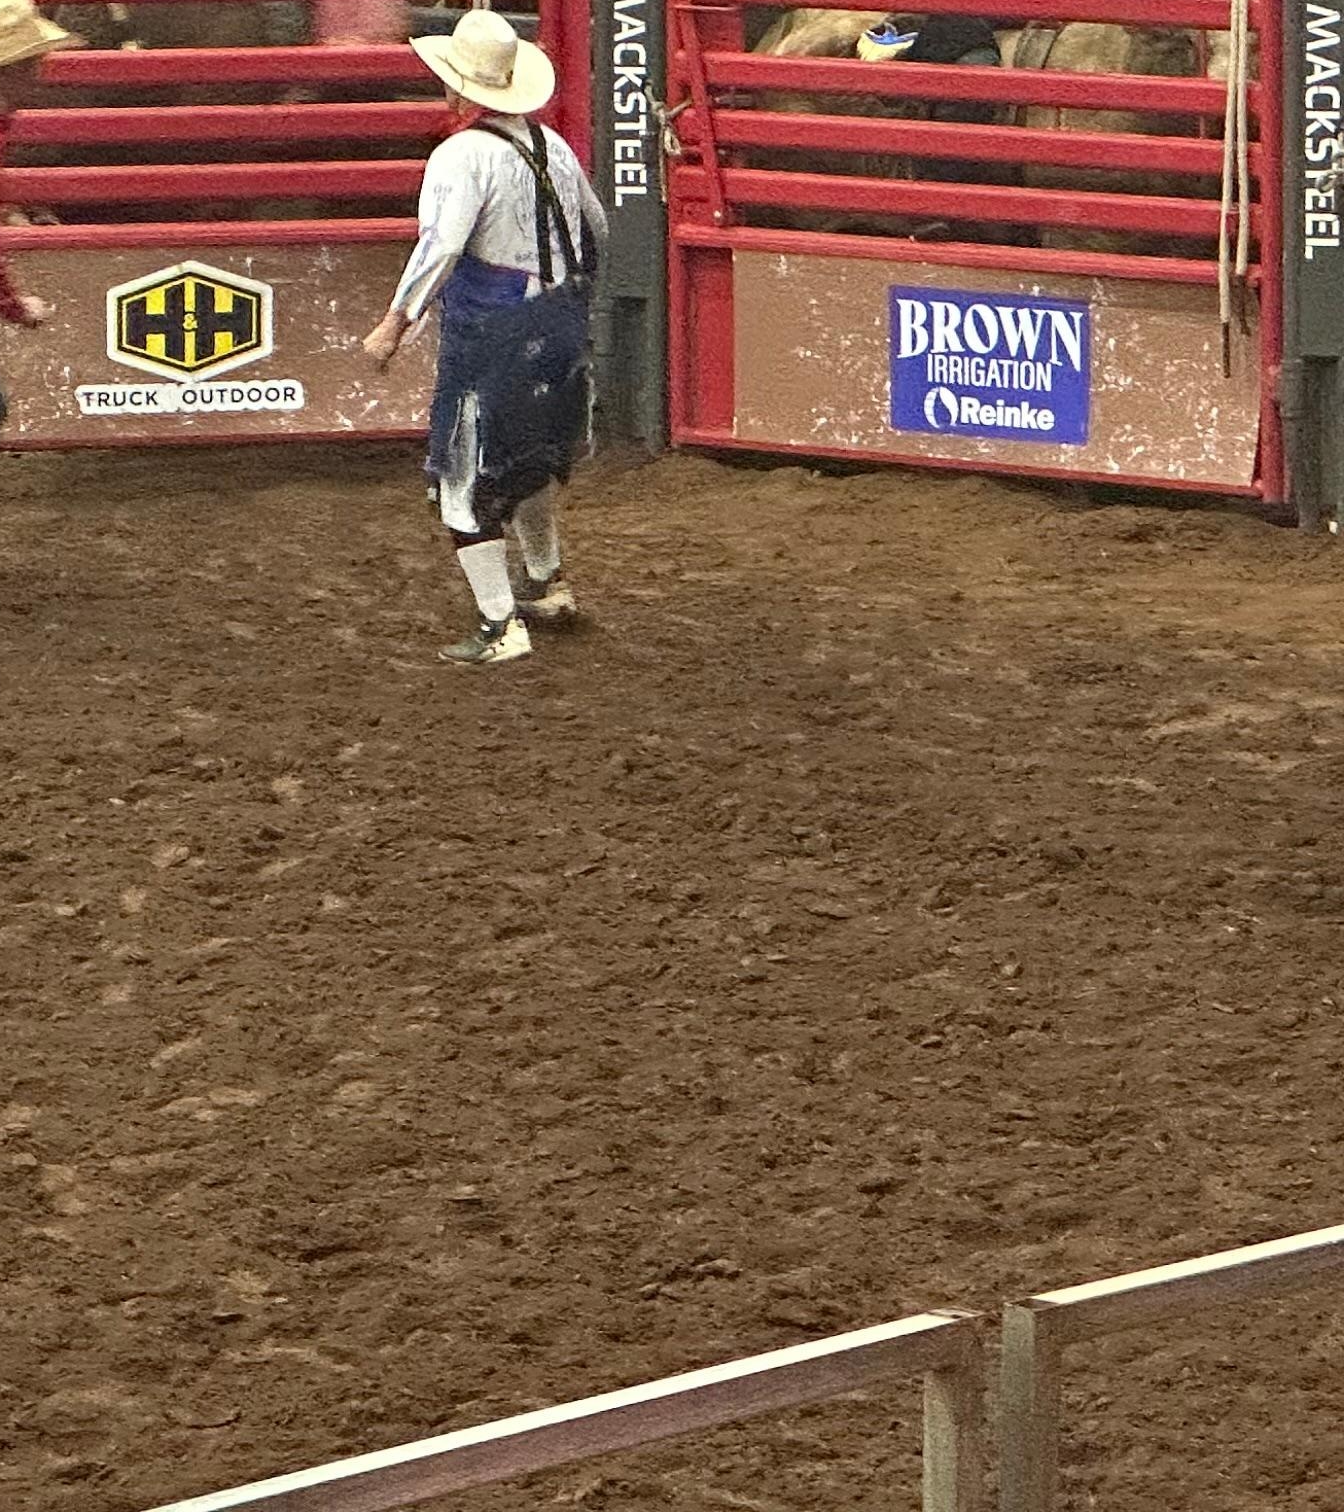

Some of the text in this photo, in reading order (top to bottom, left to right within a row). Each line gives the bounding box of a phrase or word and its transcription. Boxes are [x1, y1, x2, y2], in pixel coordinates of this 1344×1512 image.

[896, 298, 1084, 372] BROWN
[927, 353, 1052, 392] IRRIGATION
[82, 387, 297, 407] TRUCK OUTDOOR
[960, 395, 1055, 430] Reinke
